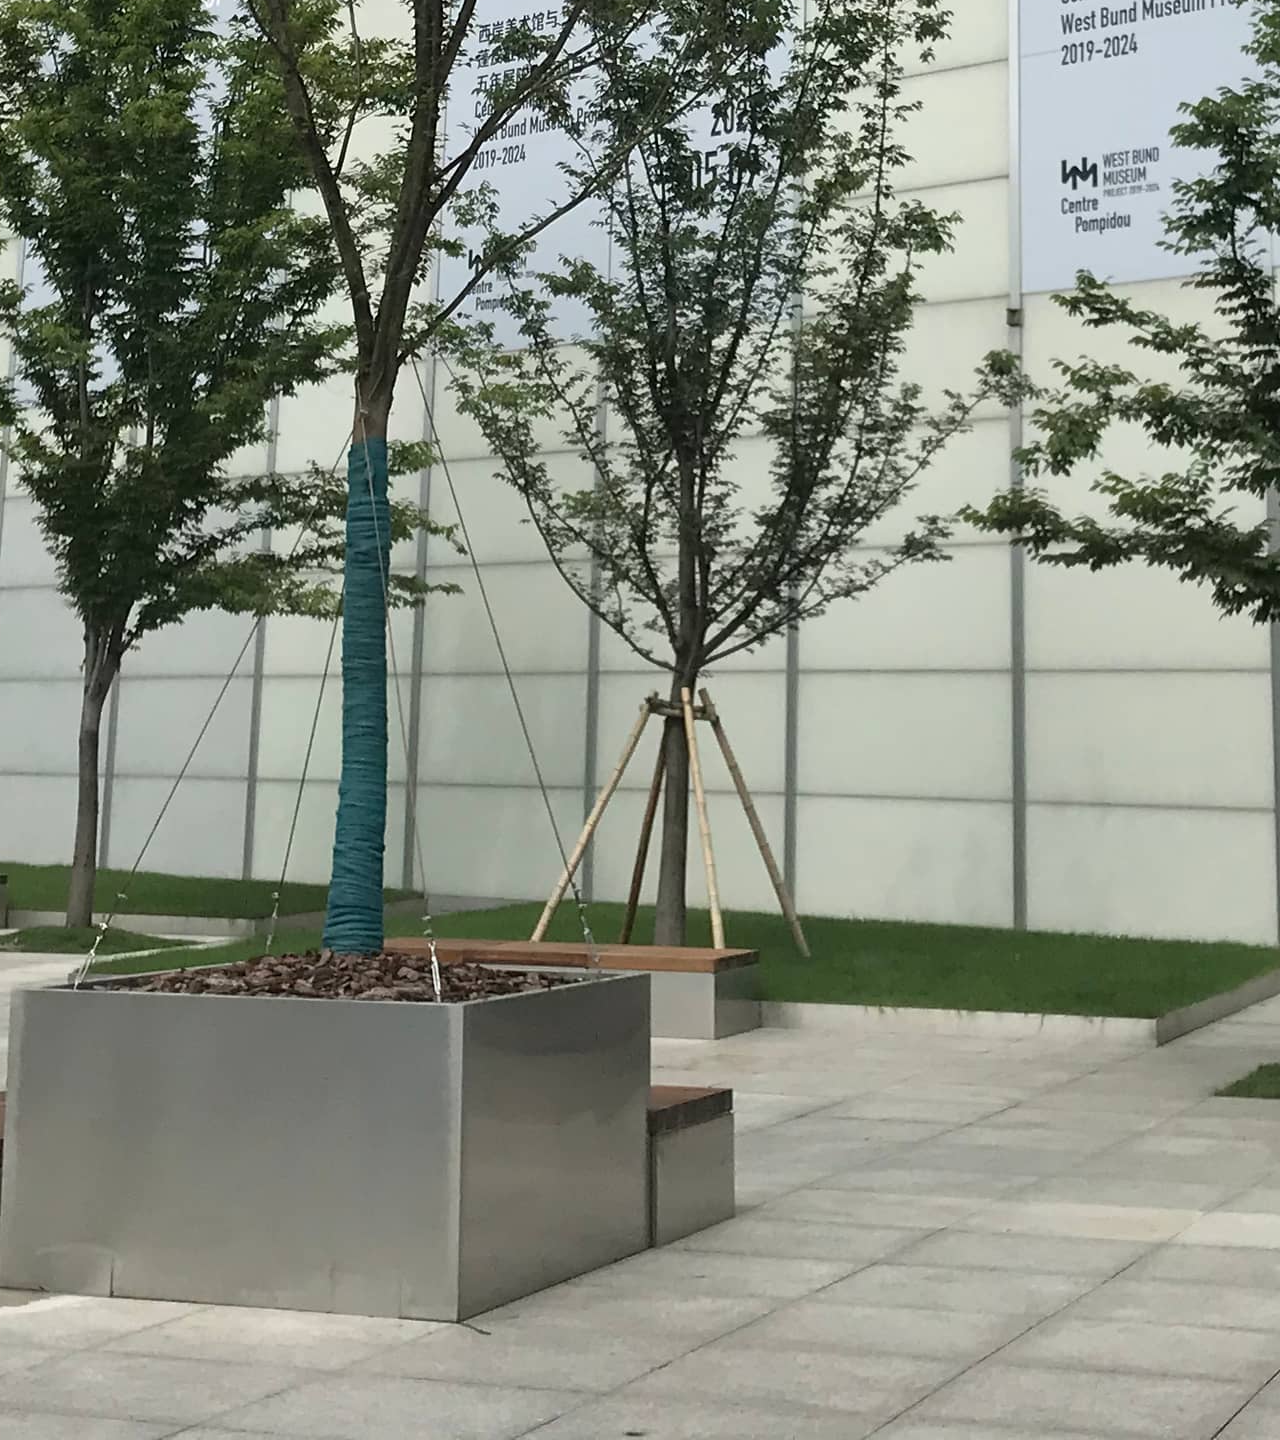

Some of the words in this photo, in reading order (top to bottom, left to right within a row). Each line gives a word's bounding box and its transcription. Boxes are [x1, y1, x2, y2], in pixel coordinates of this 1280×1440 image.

[1060, 11, 1097, 36] West
[1100, 2, 1138, 29] Bund
[1061, 32, 1139, 67] 2019-2024
[473, 144, 526, 170] 2019-2024
[1102, 150, 1130, 169] WEST
[1132, 147, 1160, 165] BUND
[1102, 166, 1147, 187] MUSEUM
[1061, 196, 1099, 215] Centre
[1075, 212, 1131, 235] Pompidou
